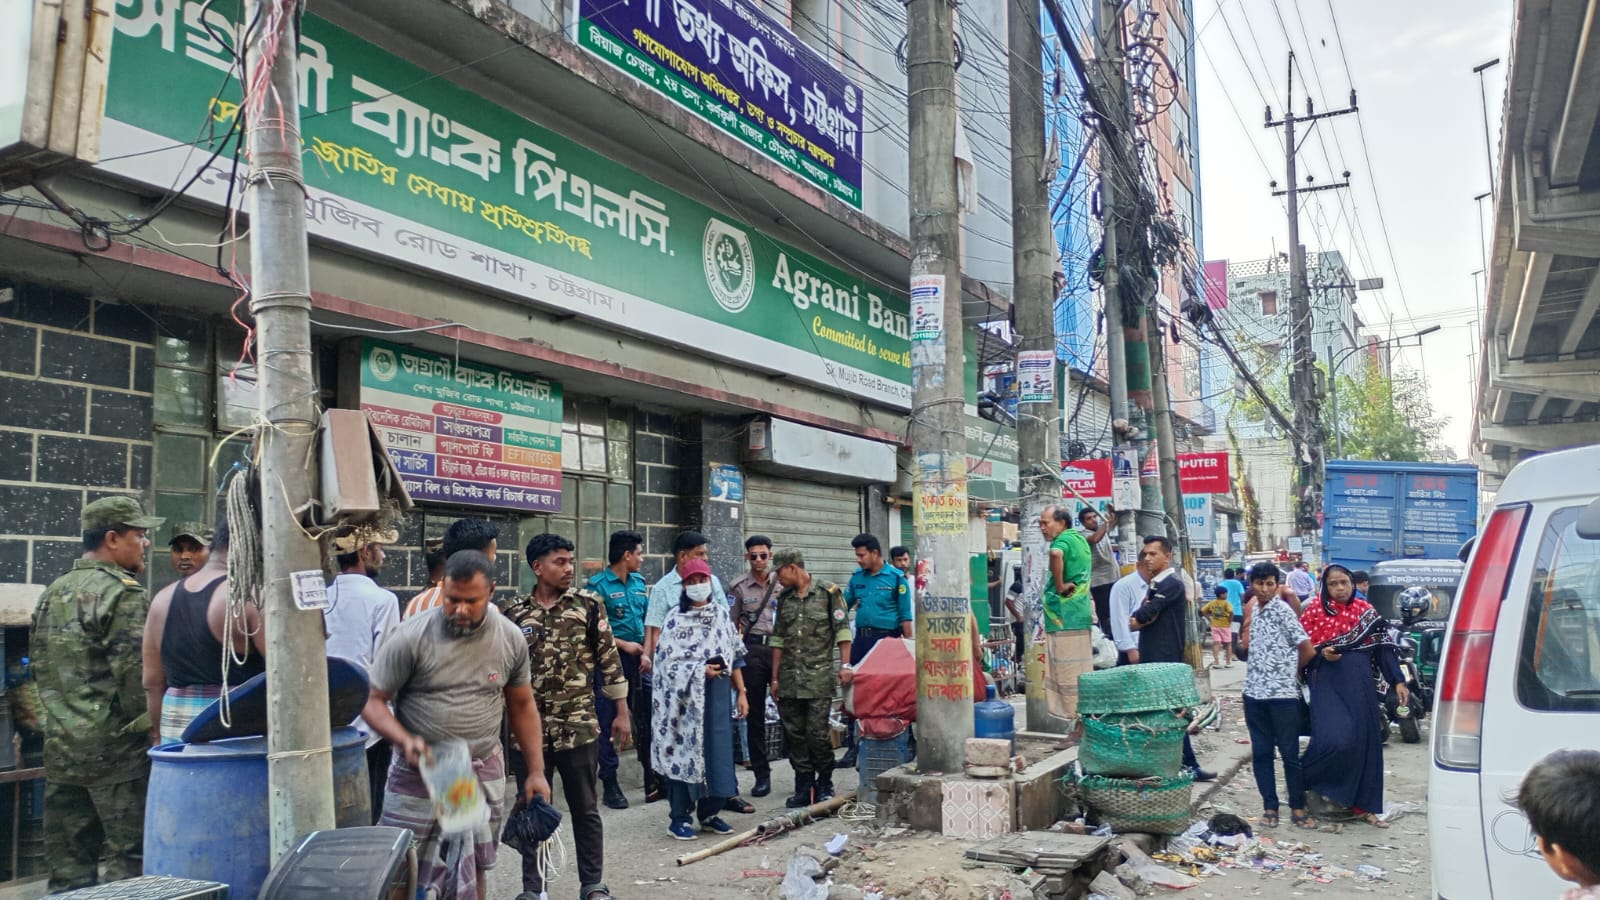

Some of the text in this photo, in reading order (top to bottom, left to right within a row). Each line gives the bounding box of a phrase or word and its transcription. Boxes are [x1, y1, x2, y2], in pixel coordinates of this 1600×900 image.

[352, 75, 500, 181] ব্যাংক
[767, 116, 775, 129] ও
[801, 81, 859, 158] চট্টগ্রাম
[312, 136, 398, 187] জাতির
[407, 172, 475, 214] সেবায়
[480, 200, 594, 259] প্রতিশ্রুতিবদ্ধ
[394, 227, 461, 261] রোড
[772, 252, 861, 321] Agrani
[868, 293, 912, 341] Ban
[813, 316, 912, 369] Committed to serve th
[400, 353, 451, 382] অগ্রণী
[455, 365, 495, 390] ব্যাংক
[839, 367, 857, 384] Mujib
[859, 373, 875, 389] Road
[412, 383, 433, 394] শেখ
[435, 386, 460, 399] মুজিব
[463, 393, 482, 403] রোড
[386, 431, 423, 447] চালান
[403, 453, 429, 471] সার্ভিস
[424, 479, 441, 494] বিল
[442, 484, 452, 495] ও
[930, 637, 961, 653] সারা
